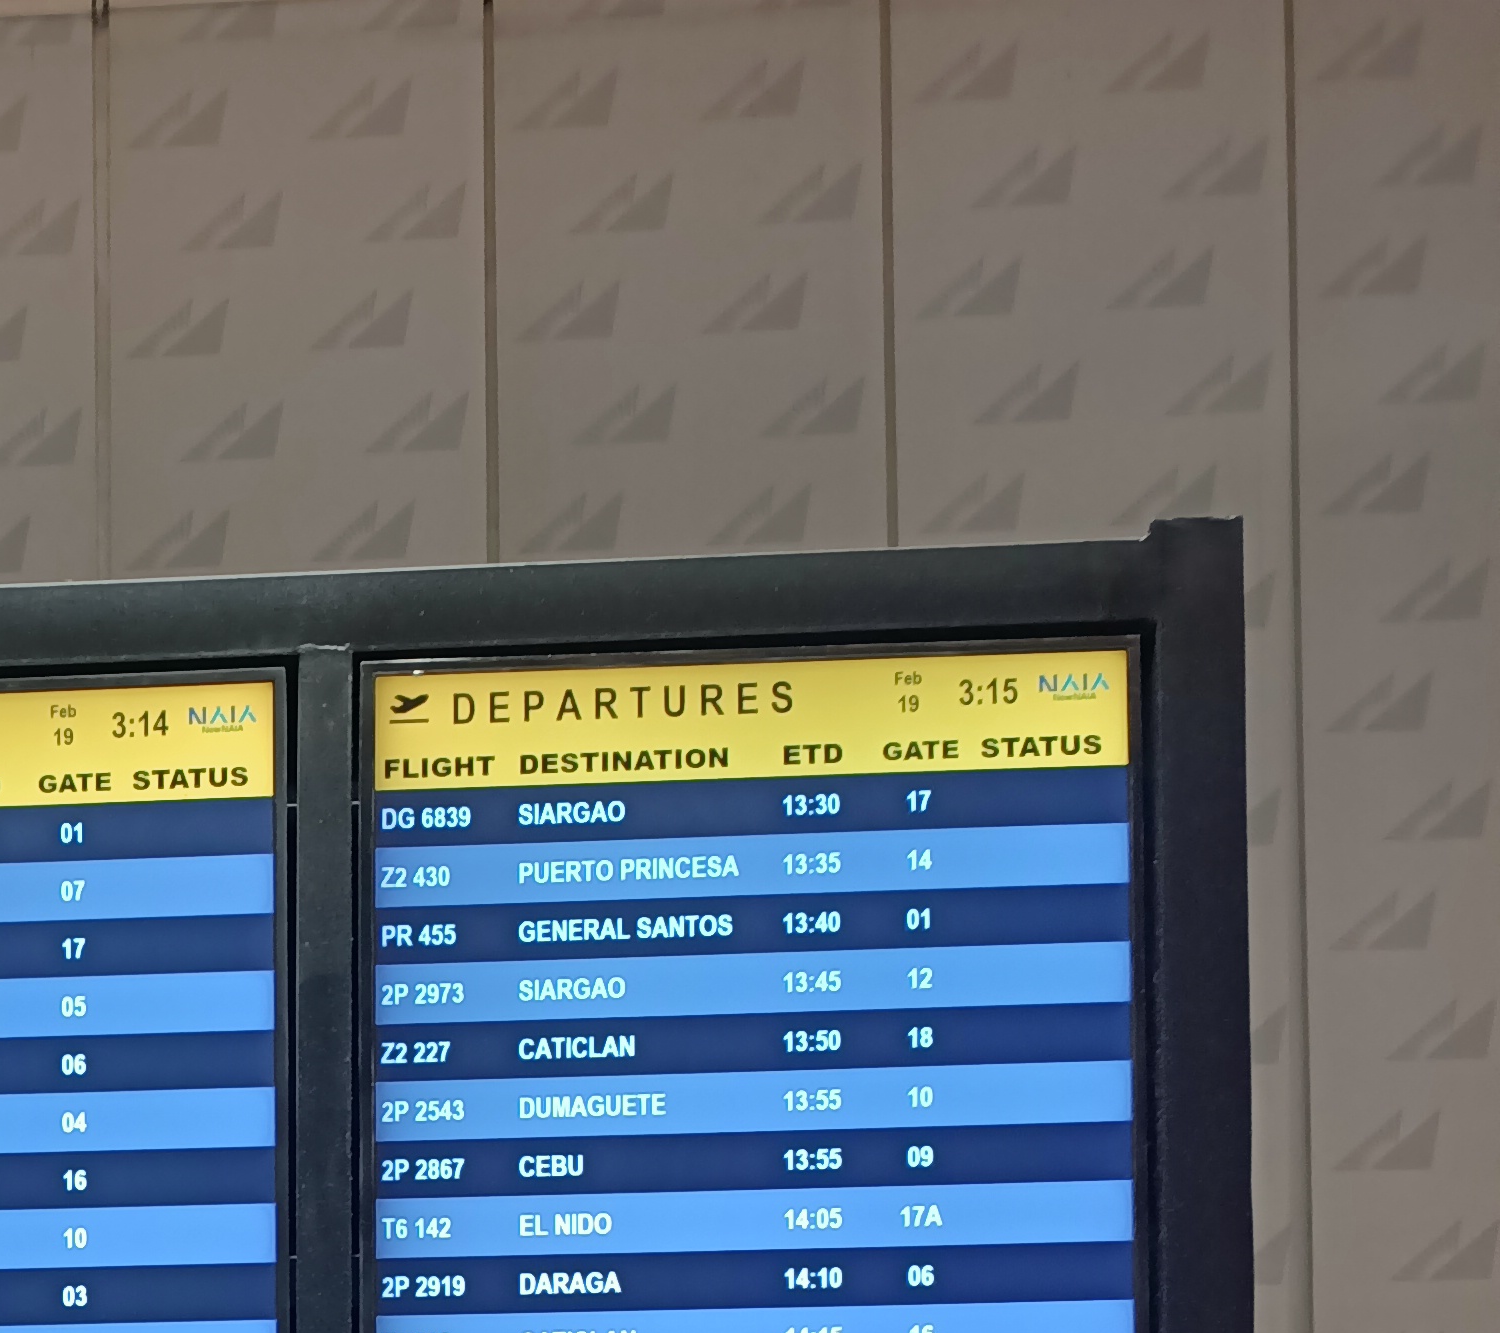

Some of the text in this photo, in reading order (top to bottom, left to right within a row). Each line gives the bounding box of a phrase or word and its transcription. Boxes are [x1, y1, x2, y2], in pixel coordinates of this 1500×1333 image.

[894, 670, 923, 686] Feb
[1038, 672, 1110, 693] NAIA
[452, 680, 793, 725] DEPARTURES
[958, 677, 1018, 706] 3:15
[50, 703, 77, 719] Feb
[188, 704, 257, 725] NAIA
[897, 694, 920, 713] 19
[111, 709, 169, 739] 3:14
[53, 727, 74, 746] 19
[384, 734, 1102, 780] FLIGHT DESTINATION ETD GATE STATUS
[38, 772, 112, 794] GATE
[132, 766, 249, 791] STATUS
[381, 789, 932, 830] DG 6839 SIARGAO 13:30 17
[60, 879, 86, 902] 07
[382, 907, 931, 947] PR 455 GENERAL SANTOS 13:40 01
[61, 995, 87, 1018] 05
[382, 1086, 933, 1123] 2P 2543 DUMAGUETE 13:55 10
[63, 1169, 88, 1191] 16
[383, 1204, 943, 1239] T6 142 EL NIDO 14:05 17A
[62, 1284, 88, 1307] 03
